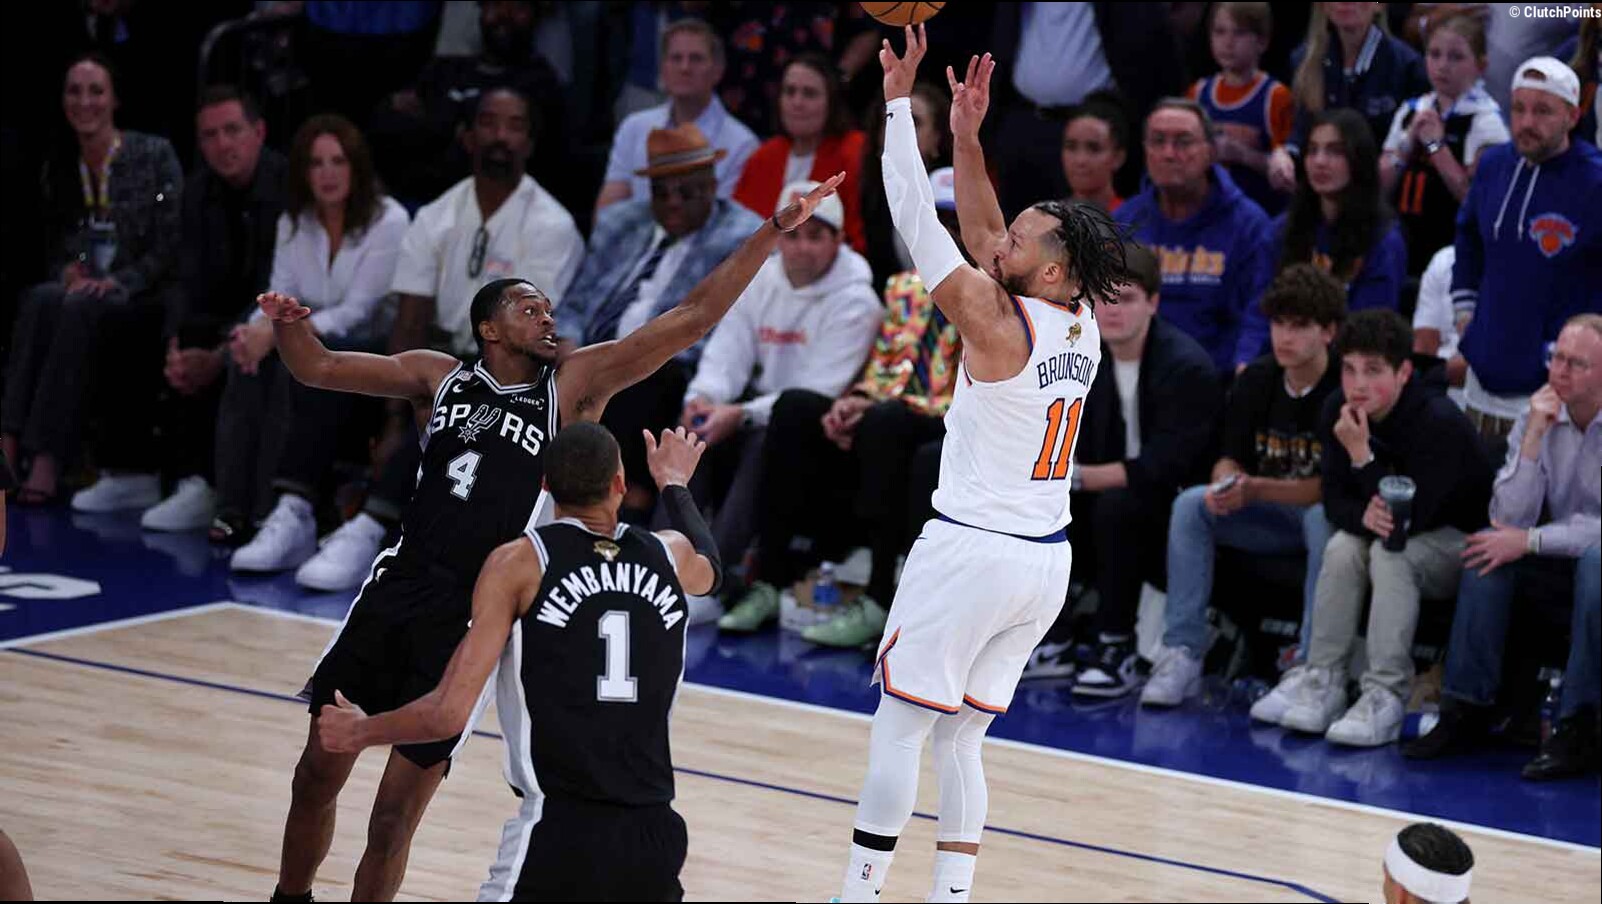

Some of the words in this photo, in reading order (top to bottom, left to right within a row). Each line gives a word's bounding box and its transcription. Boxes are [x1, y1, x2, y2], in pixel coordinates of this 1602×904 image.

[1399, 171, 1426, 214] 11
[1036, 352, 1094, 390] BRUNSON
[1031, 397, 1083, 481] 11
[446, 449, 483, 501] 4
[536, 562, 684, 631] WEMBANYAMA
[597, 610, 638, 702] 1
